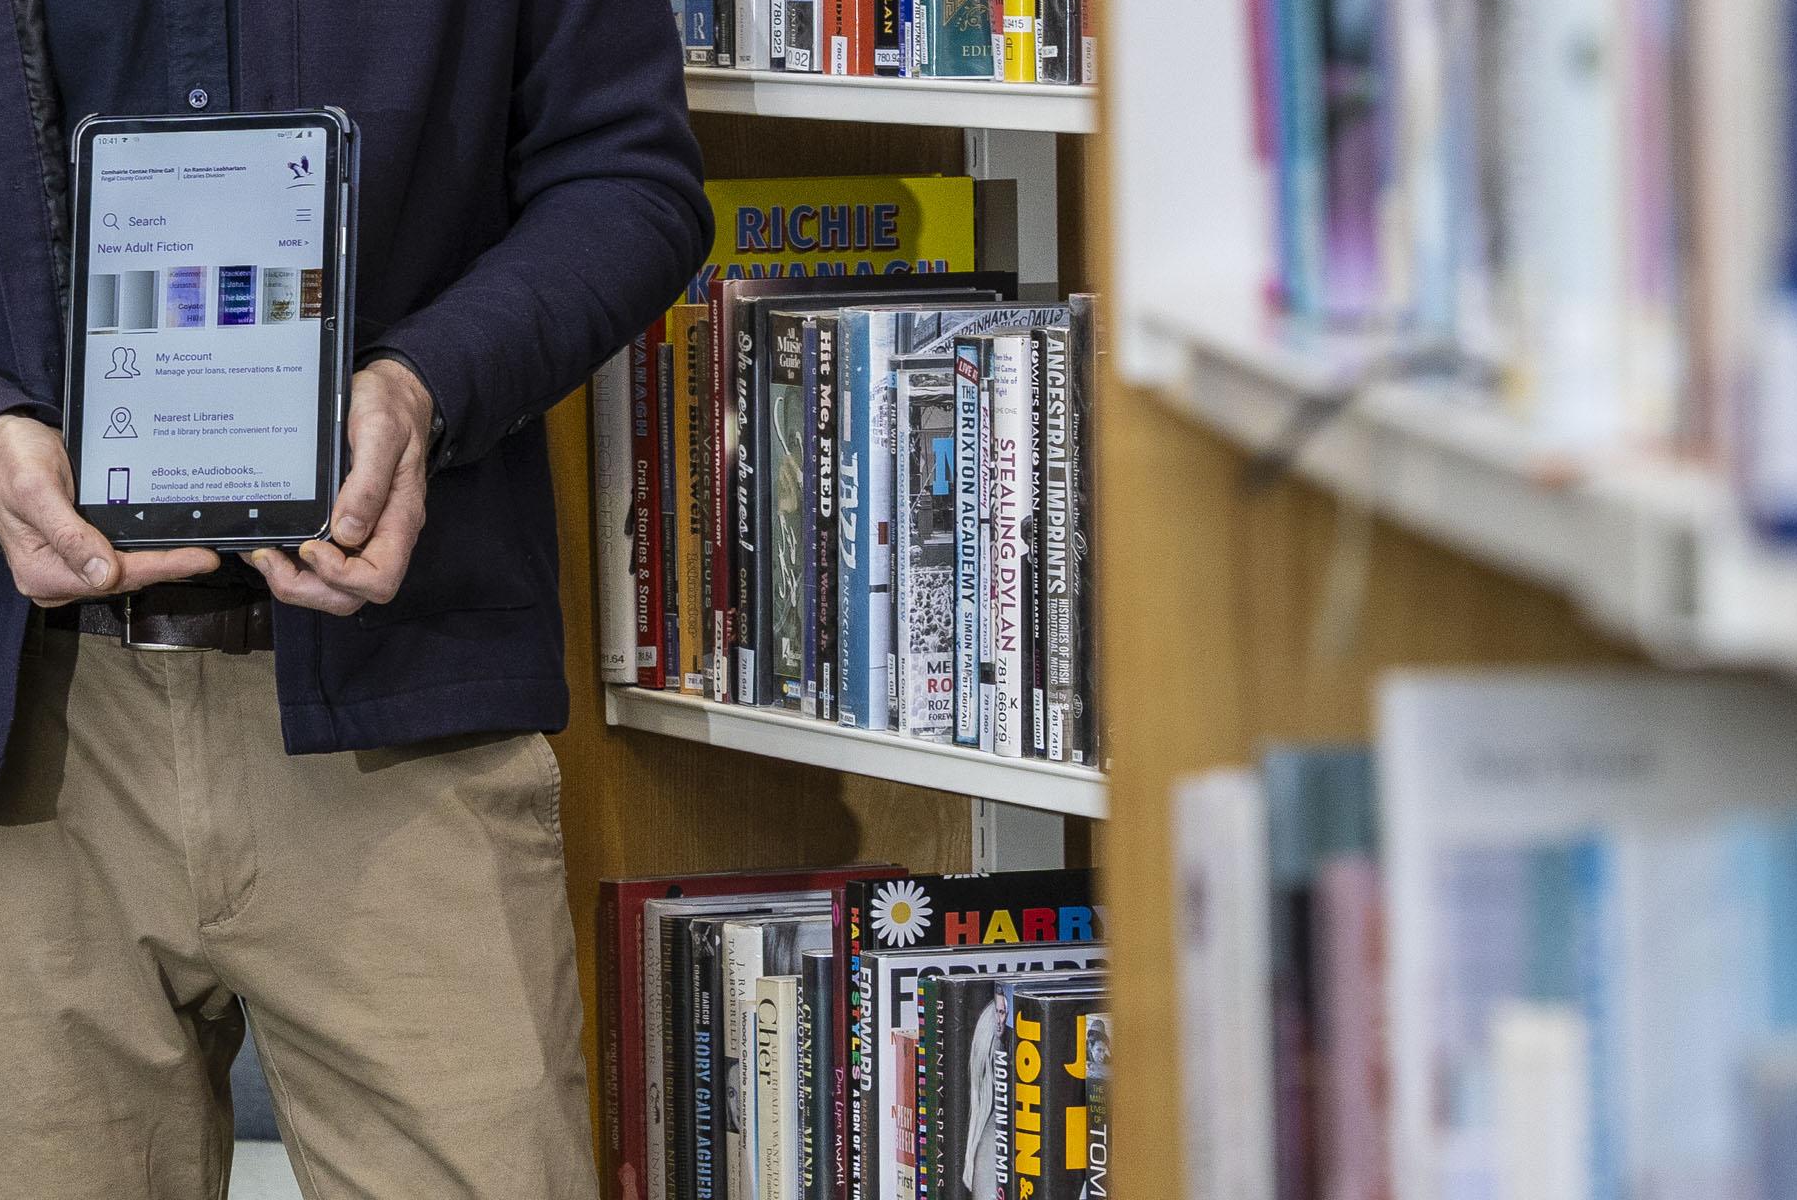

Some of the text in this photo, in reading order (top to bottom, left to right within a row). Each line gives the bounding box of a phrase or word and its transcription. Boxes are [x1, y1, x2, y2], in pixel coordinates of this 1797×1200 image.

[772, 0, 783, 54] 780.922
[98, 137, 118, 145] 10:41
[128, 215, 167, 227] Search
[278, 239, 302, 247] MORE
[735, 204, 901, 252] RICHIE
[97, 241, 194, 254] New Adult Fiction
[156, 352, 212, 363] My Account
[777, 336, 802, 353] Music
[779, 354, 801, 369] Guide
[155, 367, 185, 377] Manage
[186, 368, 203, 376] your
[204, 366, 227, 375] loans,
[228, 366, 274, 374] reservations
[276, 365, 282, 373] &
[962, 385, 975, 400] THE
[153, 428, 170, 436] Find
[177, 427, 201, 437] library
[202, 427, 228, 435] branch
[229, 426, 270, 435] convenient
[271, 425, 282, 433] for
[283, 426, 298, 435] you
[154, 412, 234, 422] Nearest Libraries
[713, 400, 719, 418] AN
[818, 330, 832, 518] Hit Me, FRED
[1030, 340, 1040, 511] BOWIE'S PIANO MAN
[152, 467, 190, 477] eBooks,
[713, 418, 721, 497] ILLUSTRATED
[738, 443, 754, 482] oh
[1047, 337, 1066, 594] ANCESTRAL IMPRINTS
[151, 480, 291, 490] Download and read eBooks & listen to
[202, 494, 231, 502] browse
[245, 493, 282, 501] collection
[637, 507, 649, 564] Stories
[738, 485, 754, 552] yes!
[962, 401, 976, 649] BRIXTON ACADEMY SIMON
[1000, 437, 1016, 653] STEALING DYLAN
[637, 567, 650, 581] &
[819, 530, 830, 652] Fred Wesley Jr.
[840, 451, 859, 692] JAZZ ENCYCLOPEDIA
[636, 584, 650, 633] Songs
[740, 567, 748, 646] CARL COX
[1049, 598, 1059, 685] TRADITIONAL MUSIC
[1059, 599, 1070, 684] HISTORIES OF IRISH
[741, 657, 749, 697] 781.648
[998, 656, 1007, 742] 781.66079
[928, 699, 950, 711] ROZ
[1010, 698, 1019, 709] K
[1051, 708, 1059, 757] 781.7415
[944, 906, 1094, 945] HARR
[701, 991, 710, 1024] MARCUS
[859, 966, 873, 1091] FORWARD
[740, 1011, 749, 1086] Woody Guthrie
[757, 998, 778, 1086] Cher
[850, 906, 861, 1179] HARRY STYLES A SIGN OF THE
[695, 1031, 712, 1199] RORY GALLAGHER
[936, 1000, 944, 1188] BRITNEY SPEARS
[995, 1050, 1008, 1184] MARTIN KEMP
[1015, 1010, 1041, 1200] JOHN &
[803, 1125, 813, 1189] MIND
